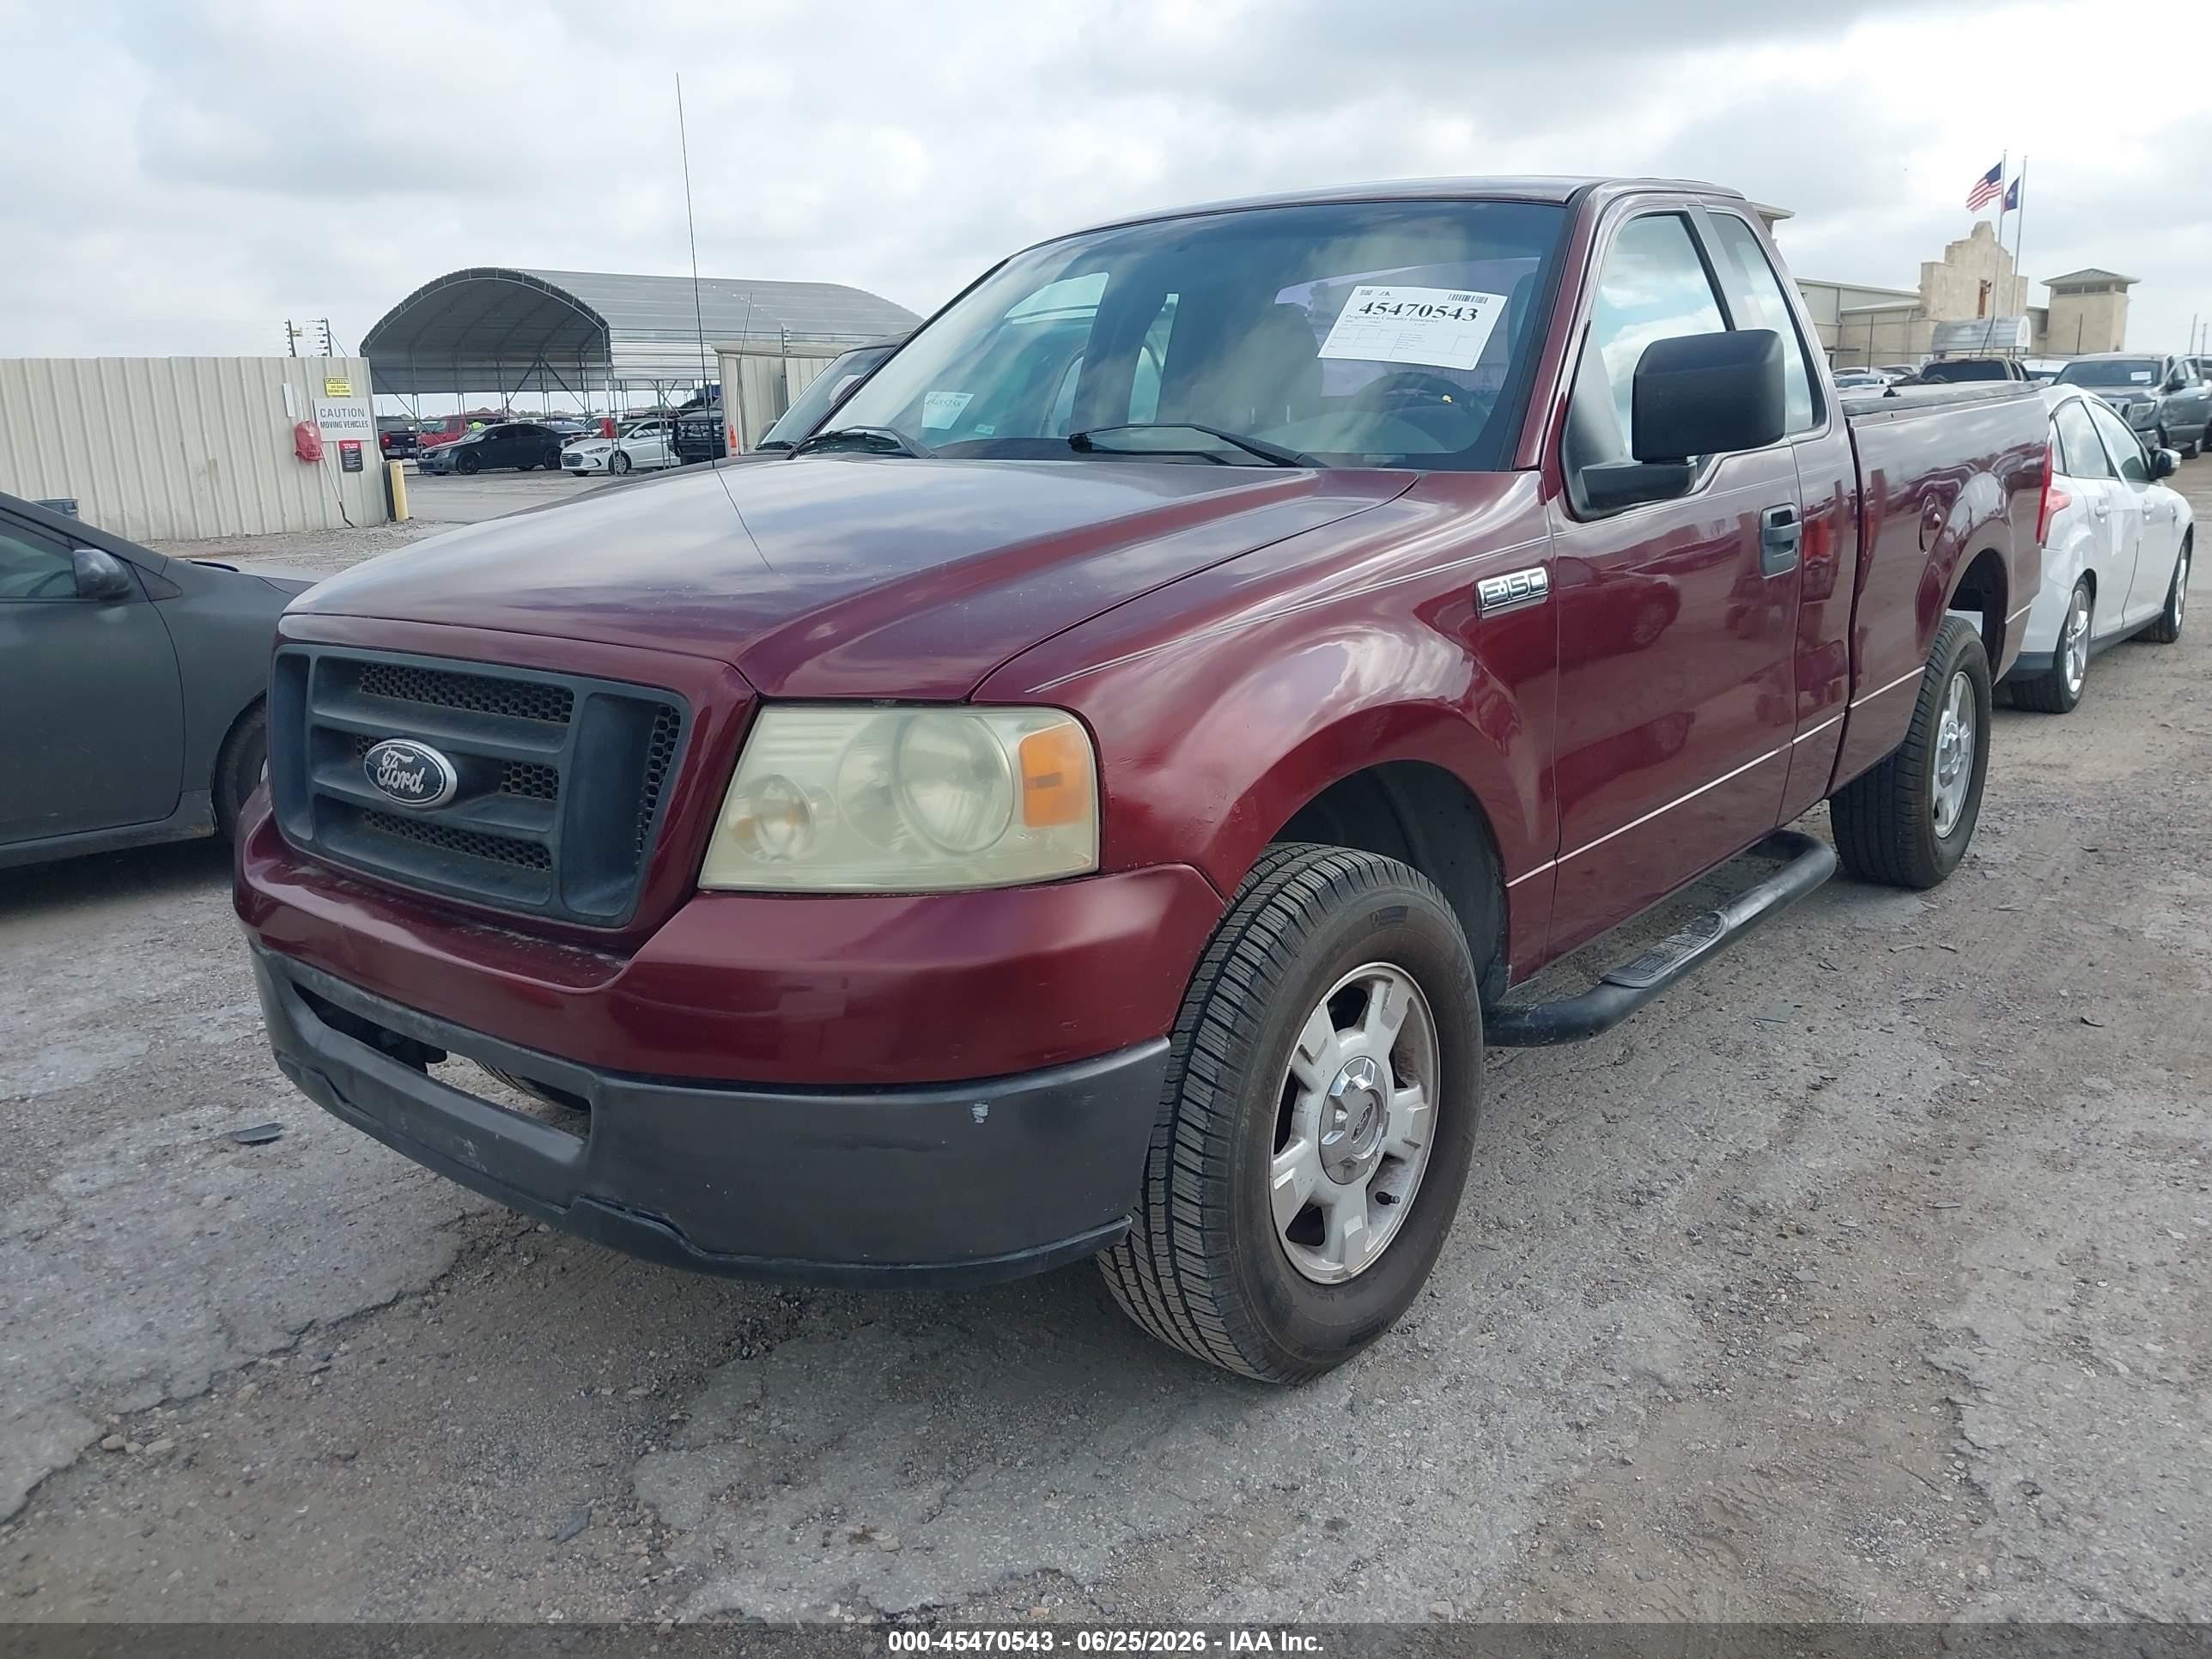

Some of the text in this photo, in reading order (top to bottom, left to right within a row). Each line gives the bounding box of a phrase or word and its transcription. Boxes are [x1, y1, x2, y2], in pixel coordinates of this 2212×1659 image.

[1358, 301, 1479, 322] 45470543
[319, 408, 365, 418] CAUTION
[343, 420, 369, 428] VEHICLES
[377, 746, 426, 793] Ford
